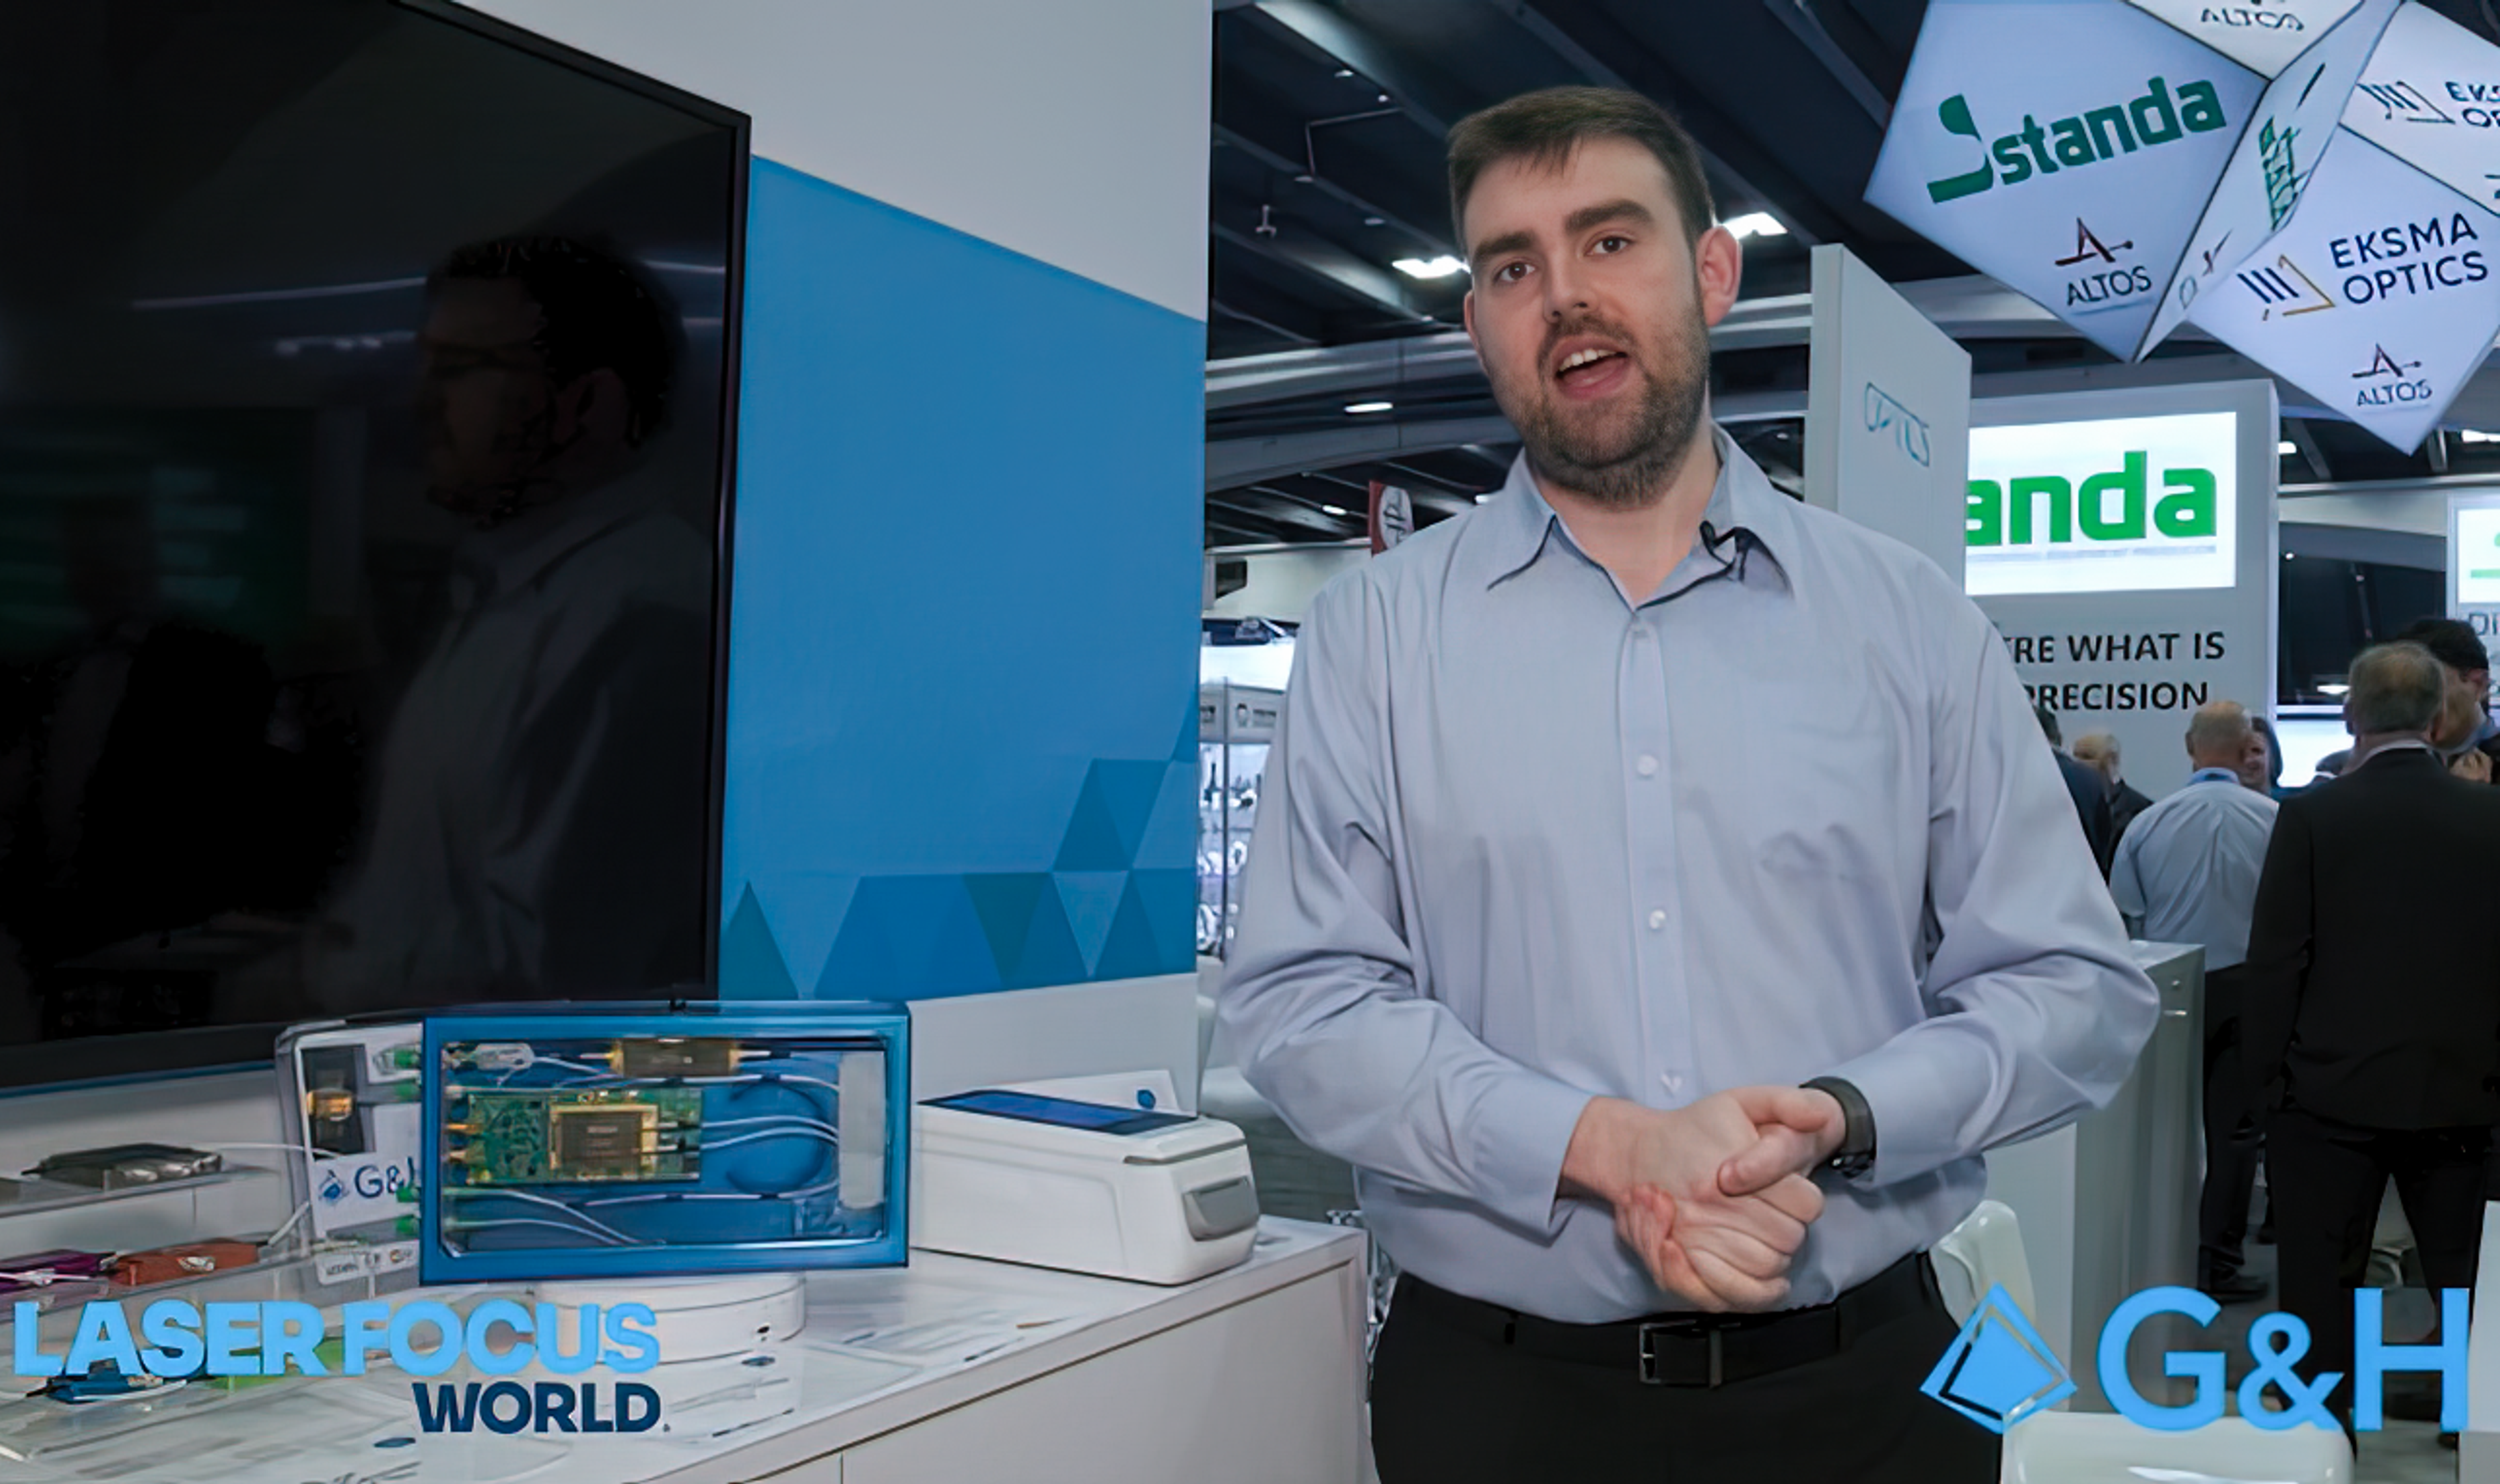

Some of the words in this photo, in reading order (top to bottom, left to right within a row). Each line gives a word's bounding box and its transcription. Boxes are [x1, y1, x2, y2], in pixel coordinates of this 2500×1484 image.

[2329, 212, 2478, 268] EKSMA
[2066, 268, 2152, 306] ALTOS
[2342, 251, 2488, 305] OPTICS
[2357, 381, 2432, 407] ALTOS
[2067, 633, 2180, 661] WHAT
[2194, 631, 2225, 660] IS
